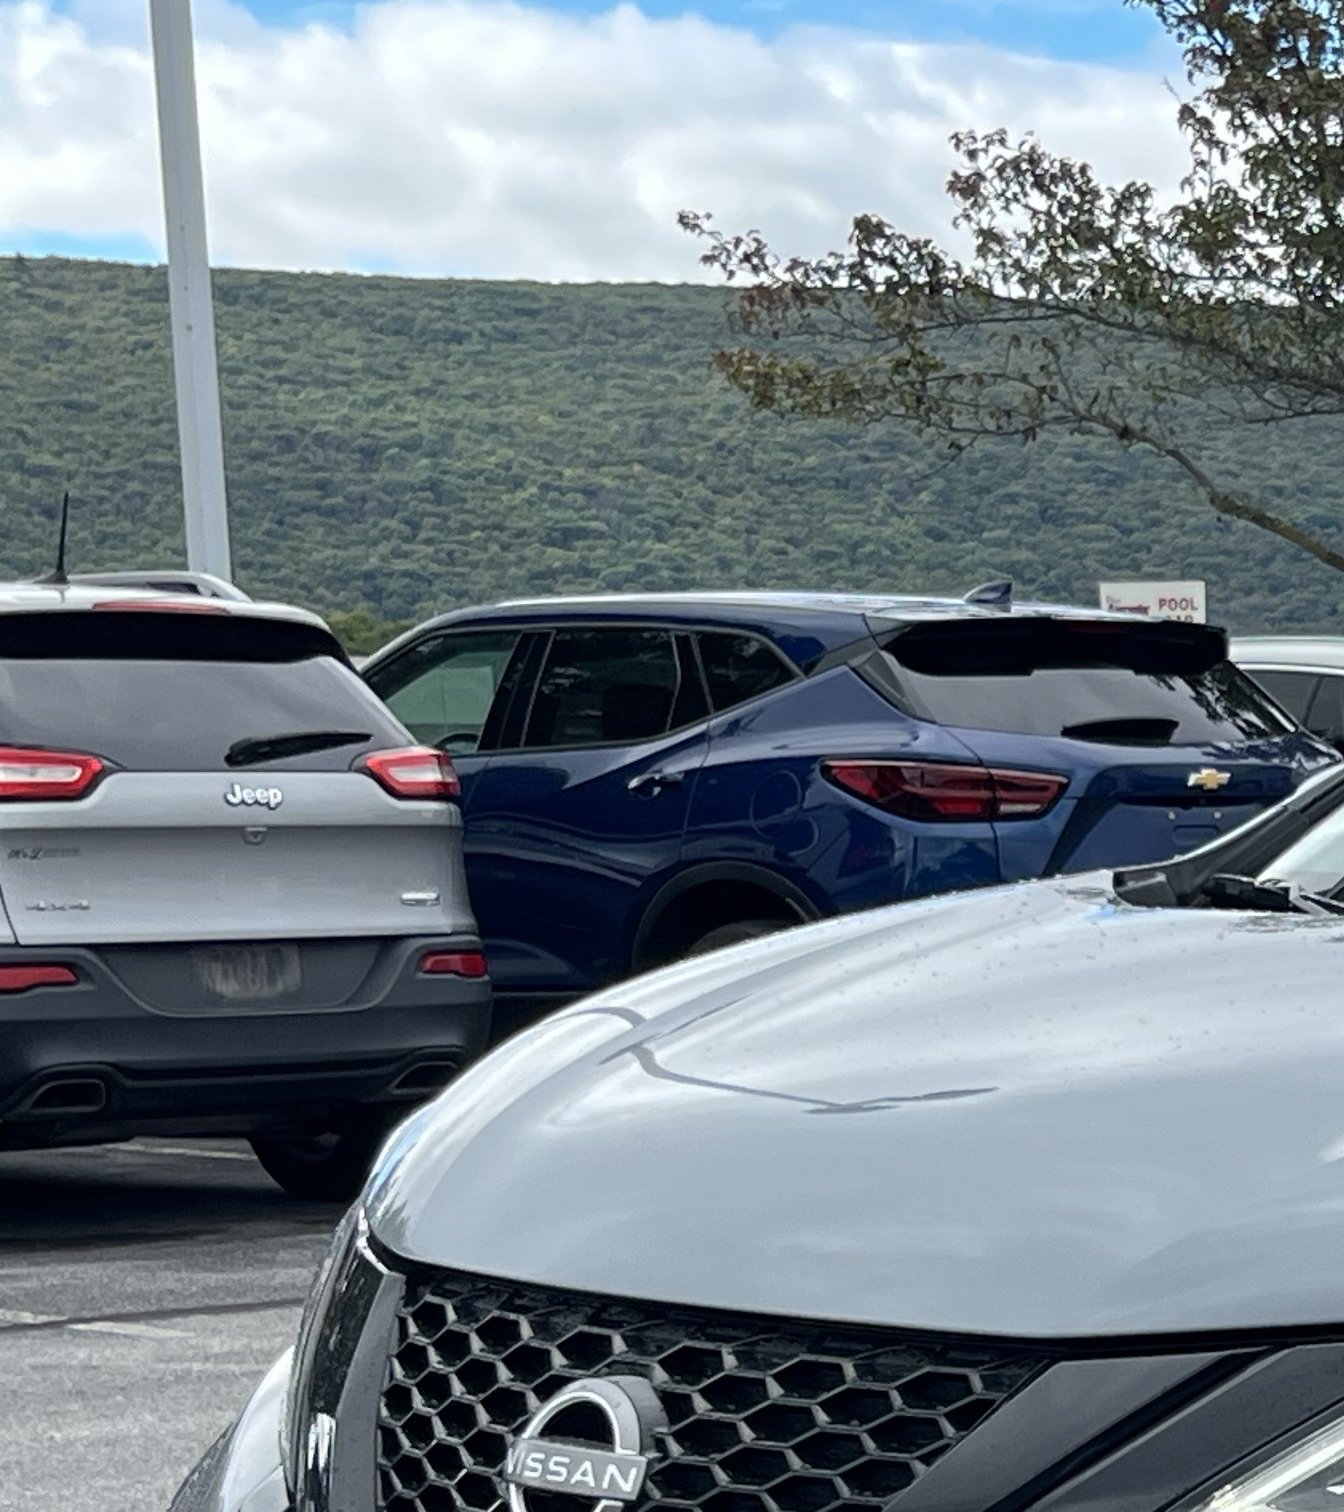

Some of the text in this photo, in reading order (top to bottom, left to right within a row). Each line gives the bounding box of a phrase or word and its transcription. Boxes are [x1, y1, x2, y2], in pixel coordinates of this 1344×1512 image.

[1158, 597, 1199, 611] POOL
[224, 783, 283, 810] Jeep
[507, 1447, 638, 1492] NISSAN
